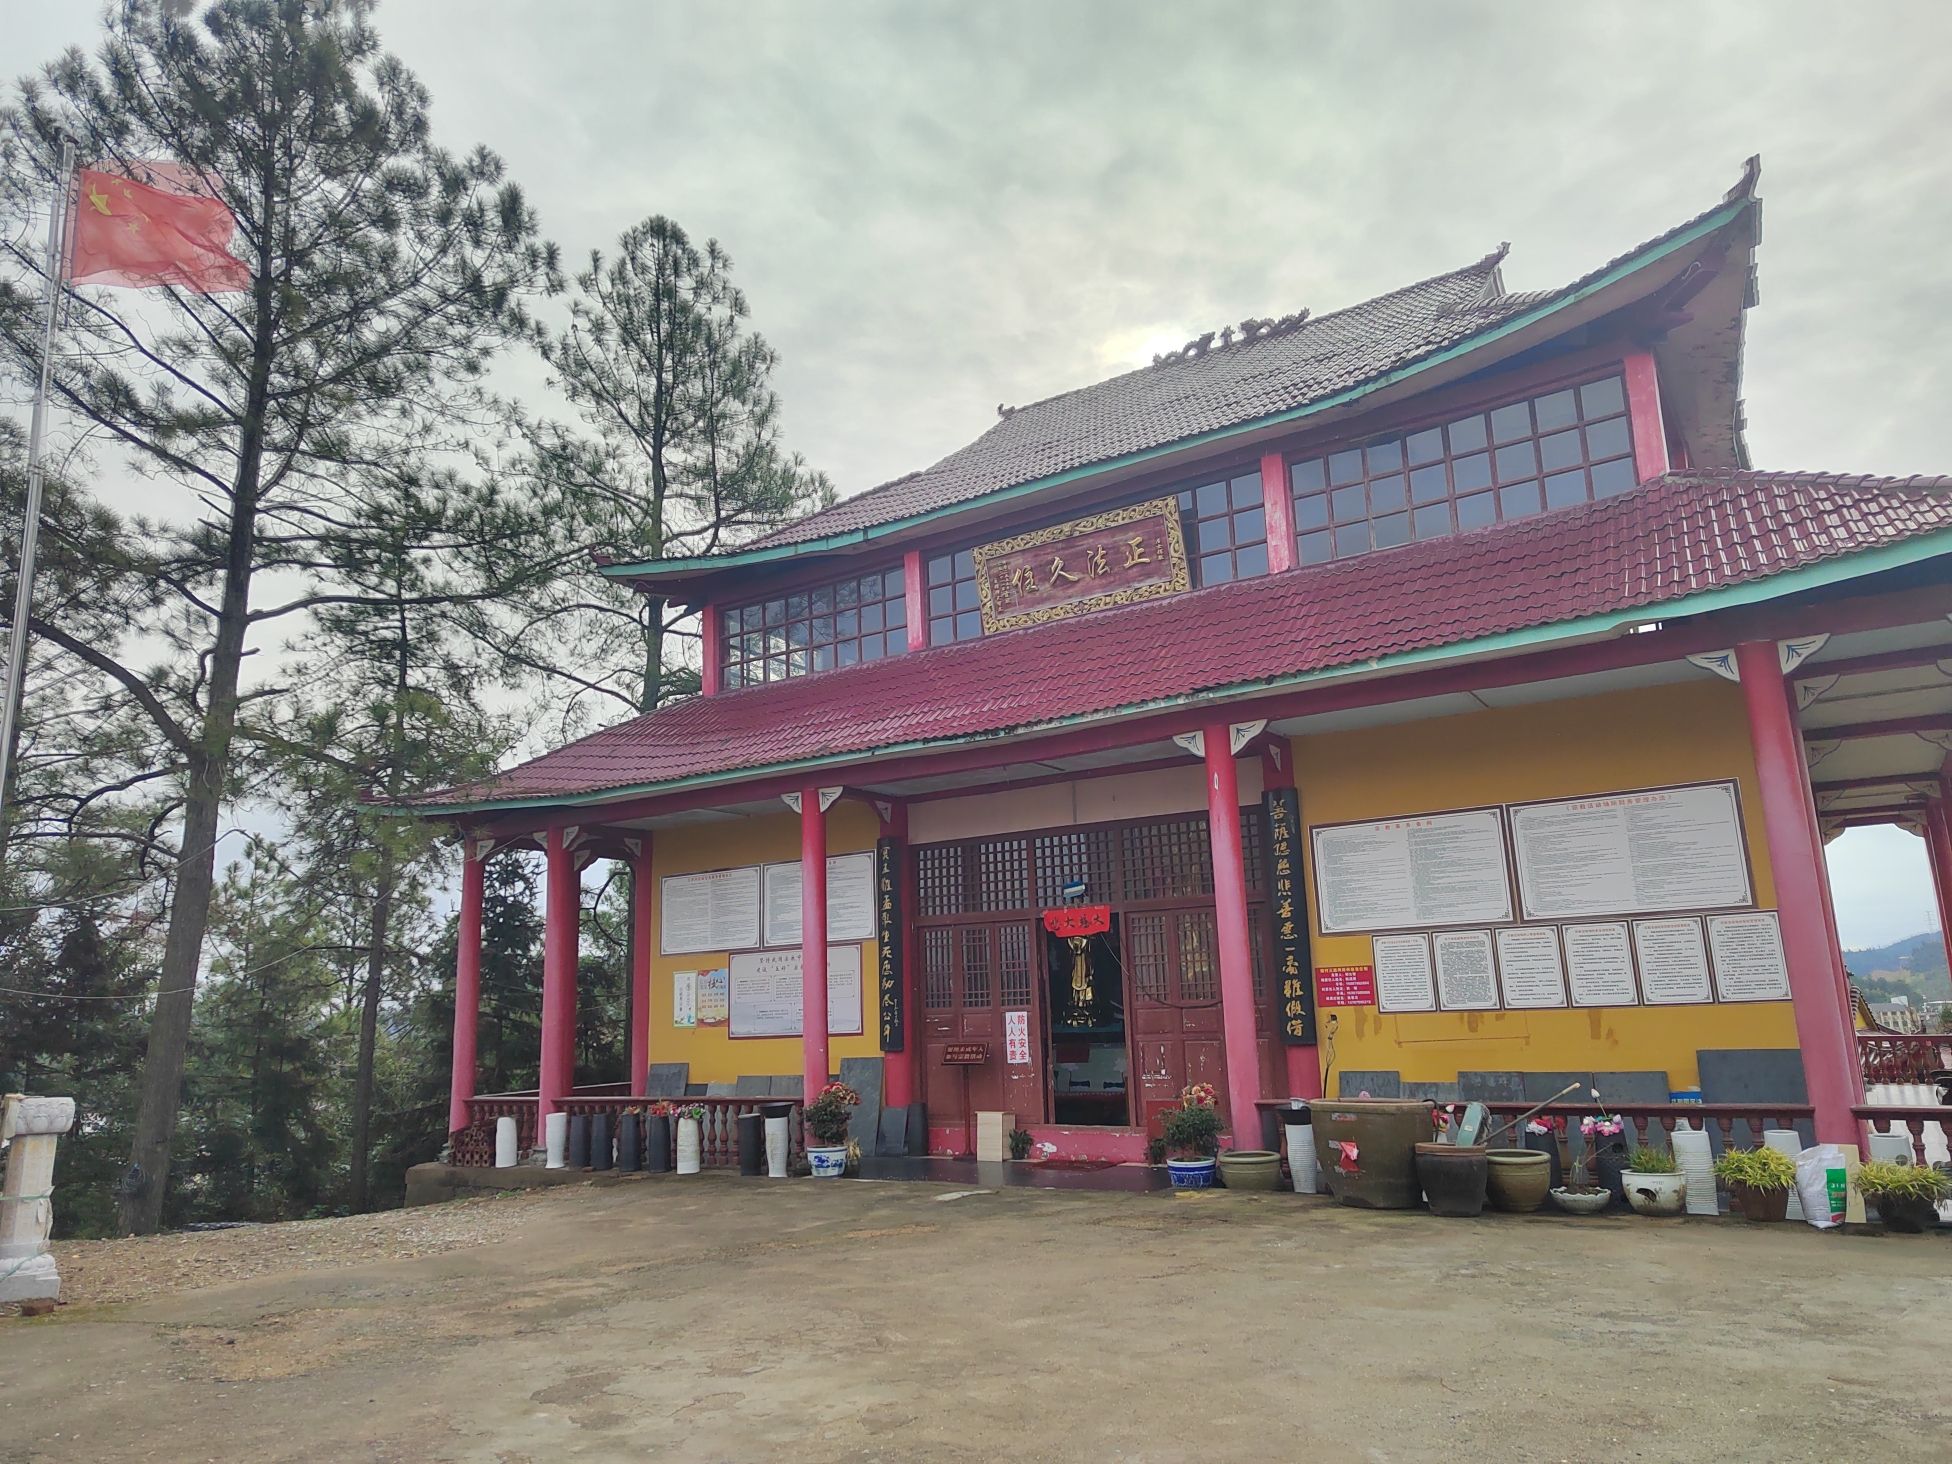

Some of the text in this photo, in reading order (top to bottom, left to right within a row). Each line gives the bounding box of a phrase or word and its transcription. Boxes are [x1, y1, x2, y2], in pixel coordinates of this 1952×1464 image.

[1011, 536, 1151, 597] 正法久住
[1008, 1015, 1018, 1061] 人人有责
[1017, 1014, 1028, 1061] 防火安全
